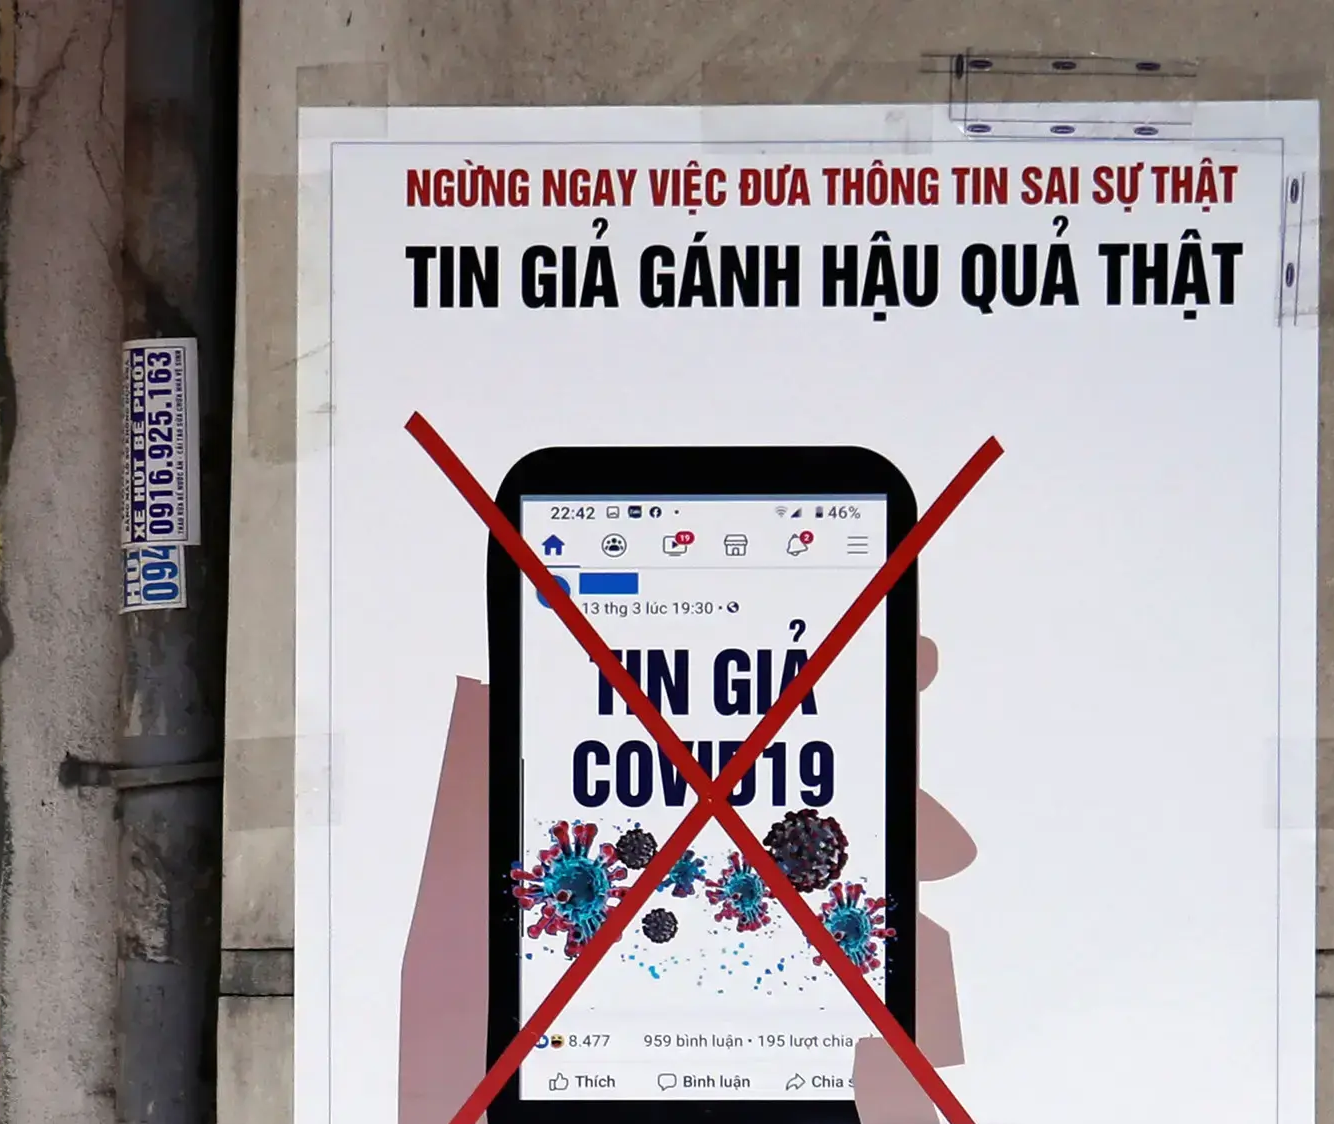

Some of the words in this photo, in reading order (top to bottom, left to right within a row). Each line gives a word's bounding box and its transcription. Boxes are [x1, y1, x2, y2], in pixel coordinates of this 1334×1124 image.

[406, 159, 530, 208] NGỪNG
[542, 168, 638, 208] NGAY
[648, 159, 727, 216] VIỆC
[738, 163, 811, 207] ĐƯA
[821, 159, 939, 206] THÔNG
[950, 166, 1008, 205] TIN
[1020, 166, 1080, 205] SAI
[1092, 164, 1140, 213] SỰ
[1151, 160, 1239, 213] THẬT
[405, 245, 499, 308] TIN
[521, 217, 619, 309] GIẢ
[639, 231, 800, 309] GÁNH
[822, 230, 939, 322] HẬU
[961, 215, 1080, 315] QUẢ
[1098, 228, 1244, 320] THẬT
[147, 351, 174, 535] 0916.925.163
[132, 458, 145, 502] HÚT
[550, 506, 596, 520] 22:42
[827, 505, 861, 520] 46%
[133, 510, 145, 539] XE
[679, 533, 691, 542] 19
[582, 601, 600, 615] 13
[604, 601, 628, 619] thg
[632, 601, 641, 615] 3
[646, 601, 668, 615] lúc
[672, 601, 714, 615] 19:30
[590, 649, 690, 716] TIN
[713, 618, 818, 716] GIẢ
[568, 1034, 611, 1048] 8.477
[643, 1034, 672, 1048] 959
[676, 1034, 708, 1048] bình
[712, 1034, 743, 1050] luận
[758, 1034, 785, 1048] 195
[789, 1034, 819, 1050] lượt
[822, 1034, 854, 1048] chia
[574, 1074, 616, 1088] Thích
[683, 1074, 716, 1088] Bình
[719, 1075, 751, 1091] luận
[811, 1075, 844, 1088] Chia
